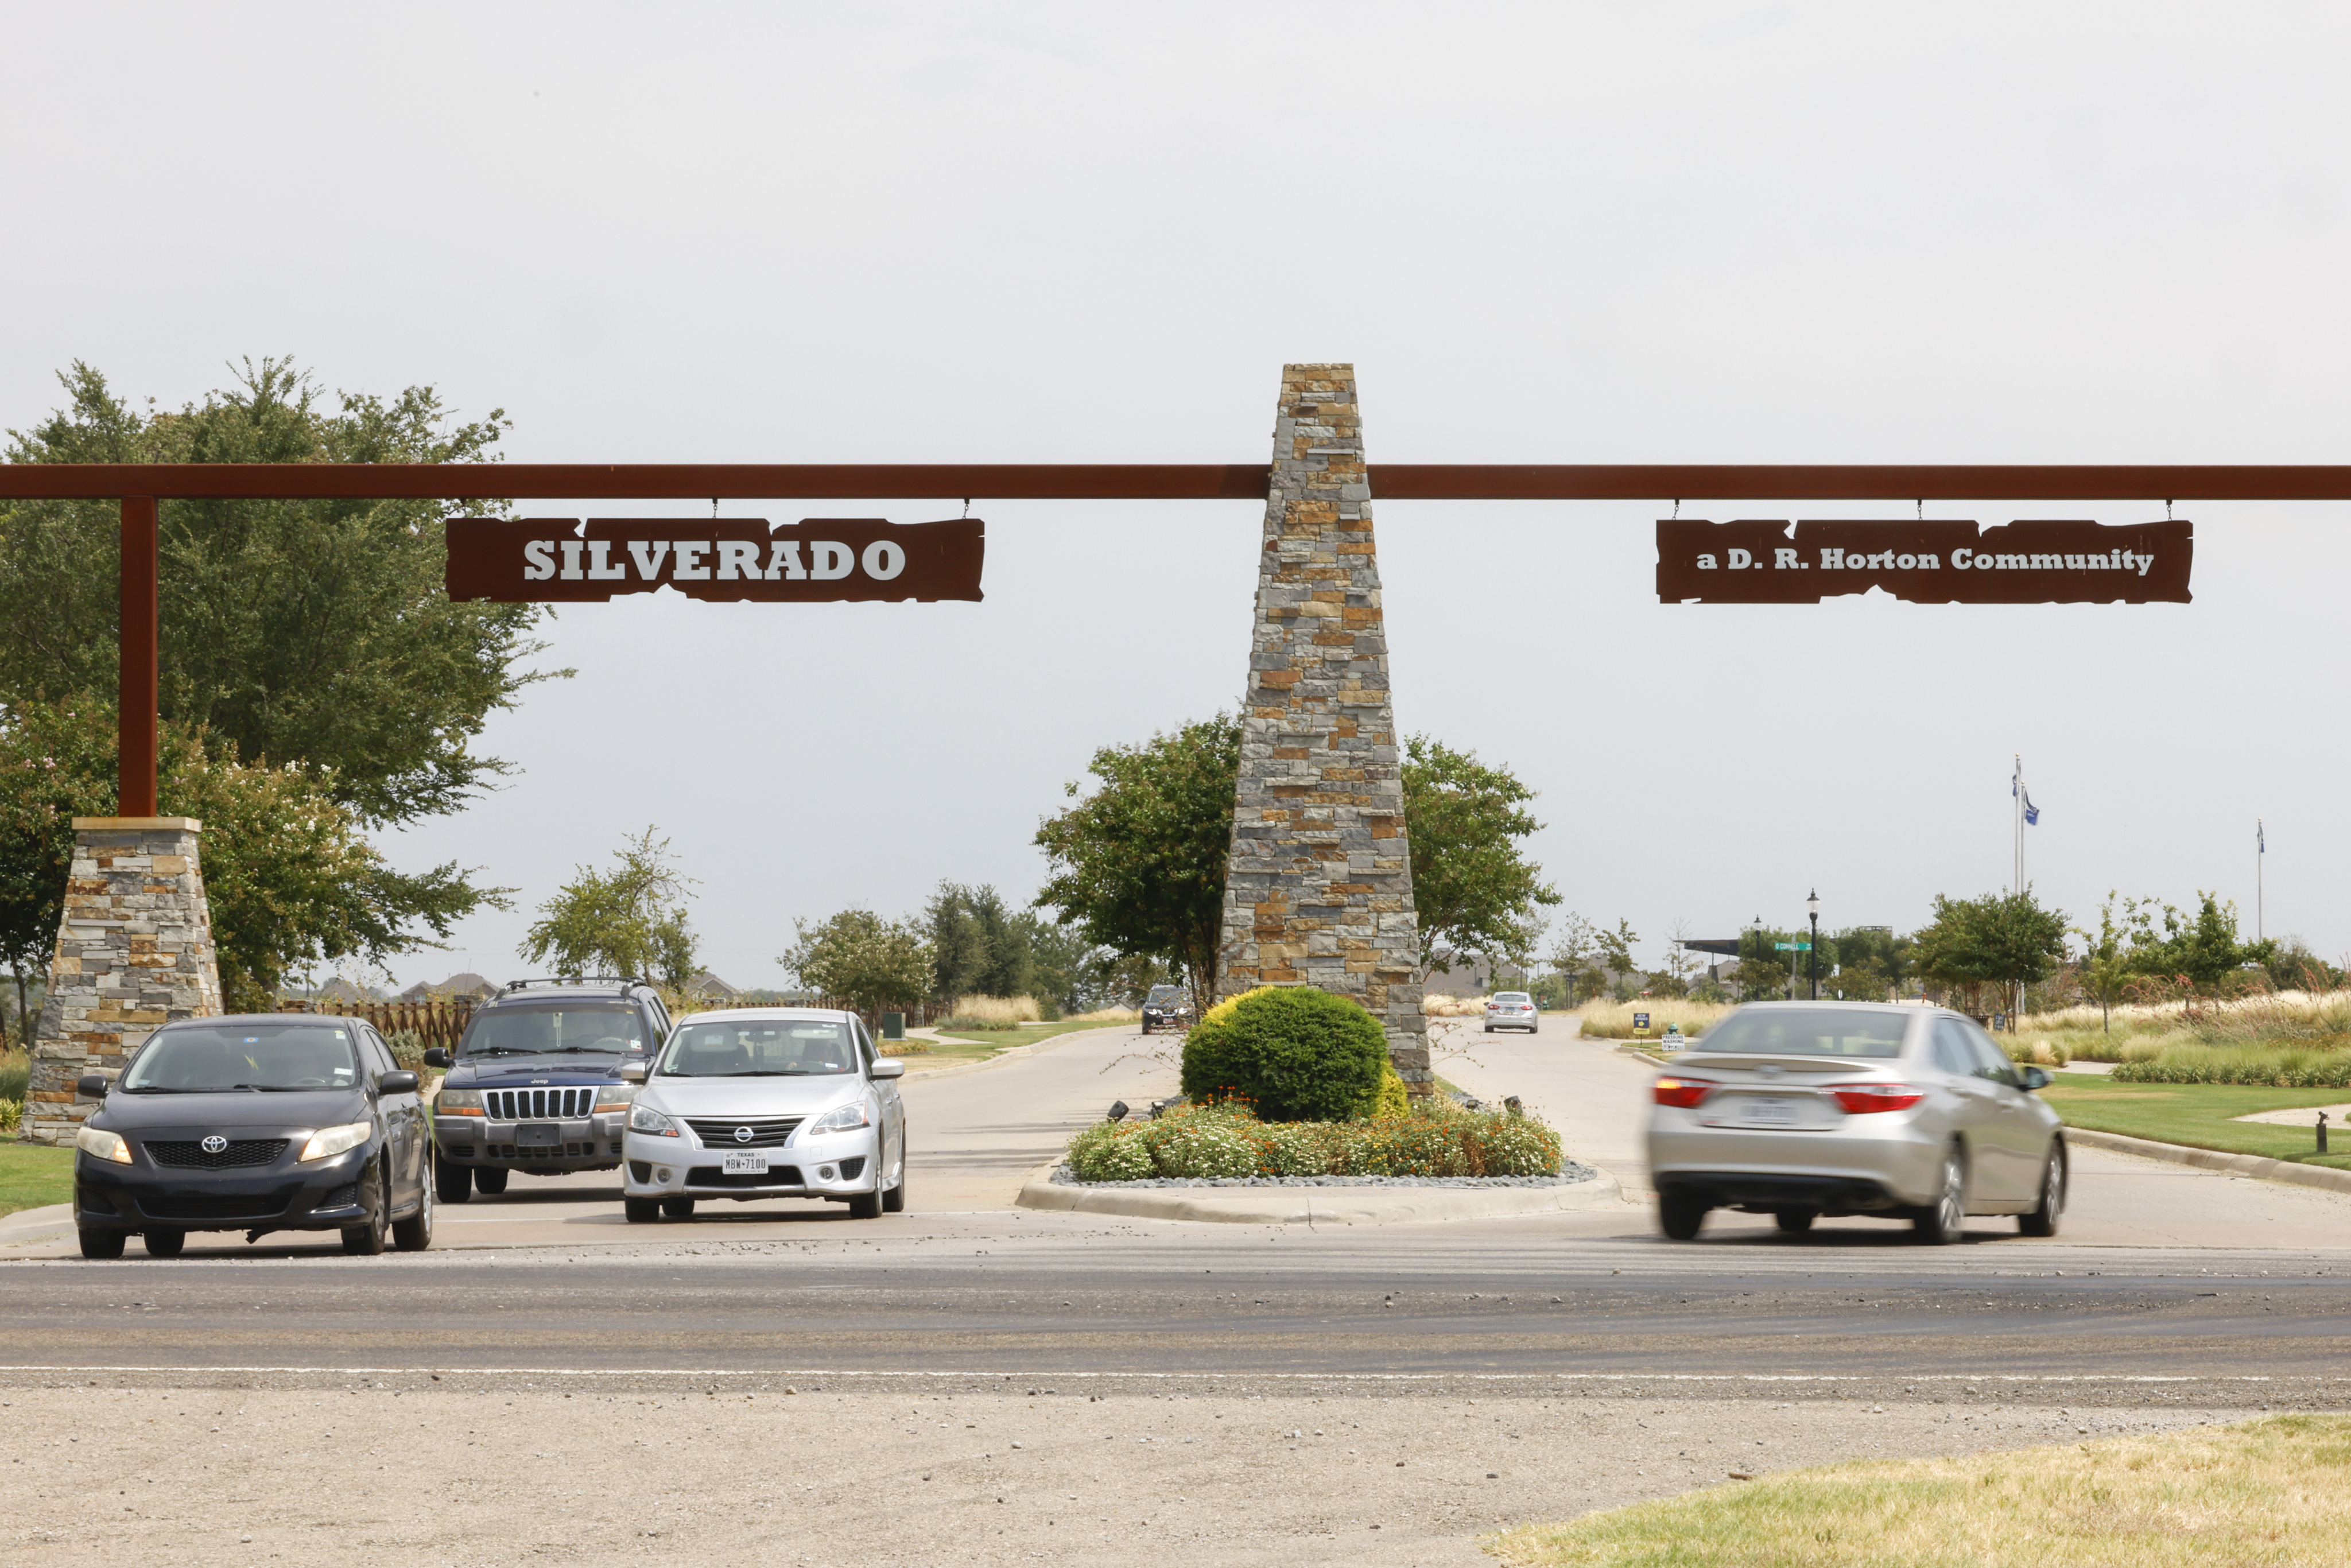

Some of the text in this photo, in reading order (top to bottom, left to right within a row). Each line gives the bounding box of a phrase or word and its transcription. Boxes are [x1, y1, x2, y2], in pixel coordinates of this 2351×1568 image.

[524, 540, 906, 580] SILVERADO
[1697, 548, 2154, 576] a D. R. Horton Community
